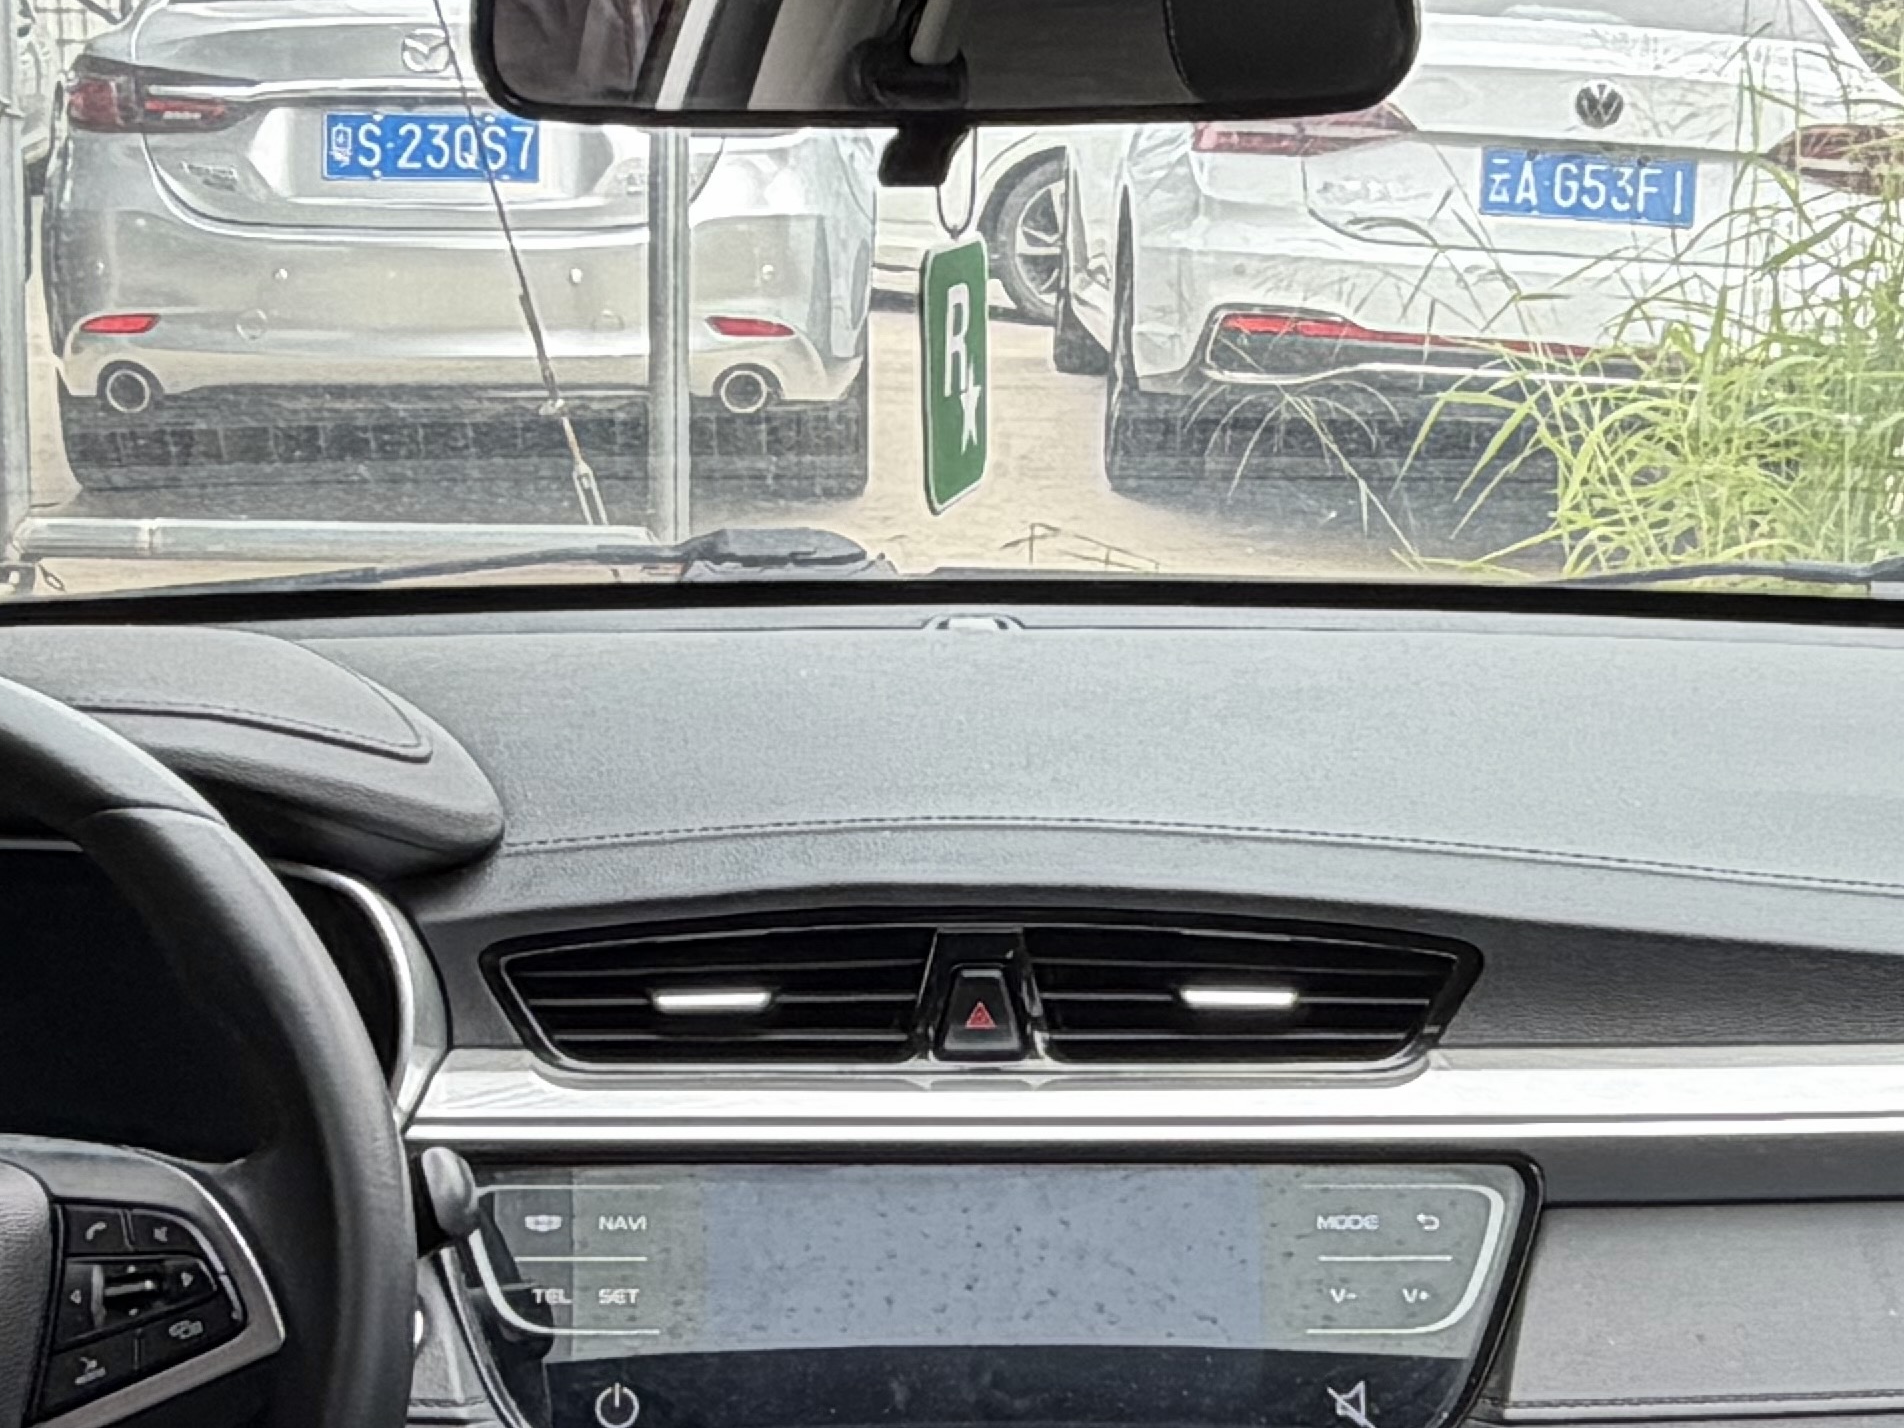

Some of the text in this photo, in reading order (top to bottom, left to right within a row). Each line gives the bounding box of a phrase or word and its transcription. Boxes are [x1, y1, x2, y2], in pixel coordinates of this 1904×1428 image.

[598, 1215, 647, 1230] NAVI
[1316, 1214, 1379, 1230] MODE
[531, 1288, 572, 1304] TEL
[598, 1288, 640, 1304] SET
